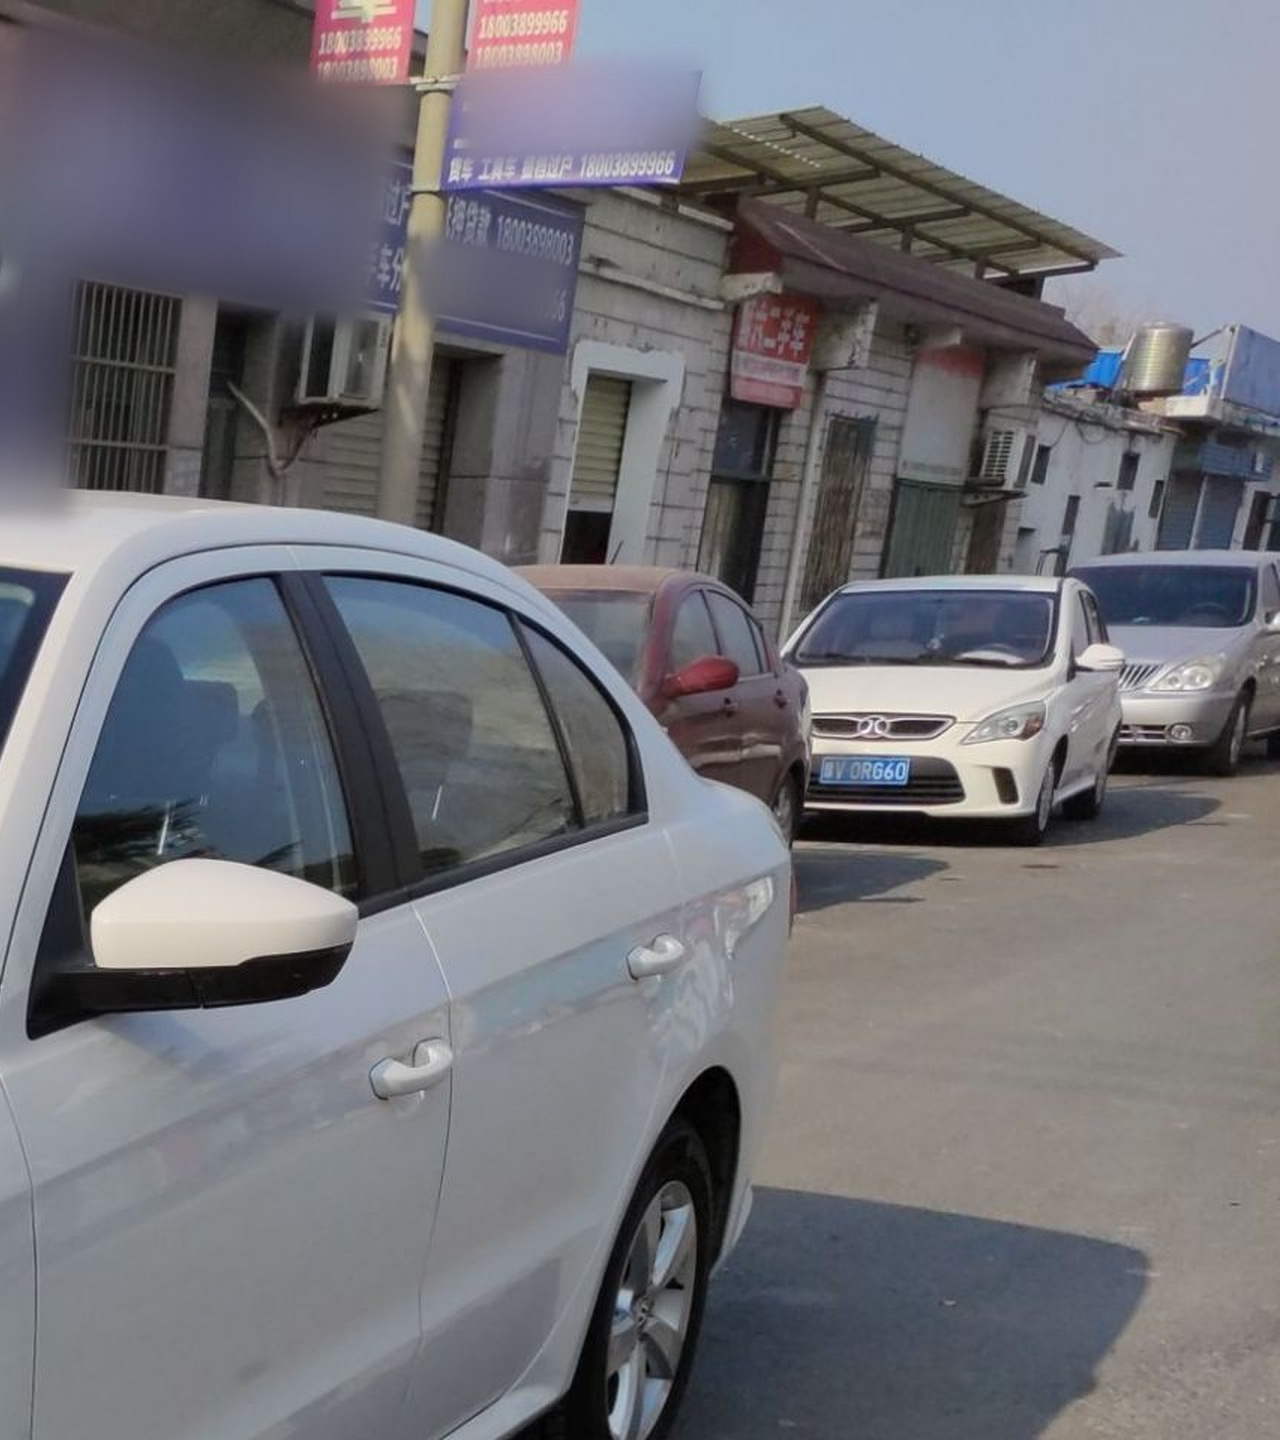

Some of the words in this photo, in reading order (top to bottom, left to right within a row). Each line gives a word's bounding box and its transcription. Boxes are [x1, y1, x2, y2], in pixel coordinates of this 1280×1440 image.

[479, 9, 568, 39] 18003899966
[580, 151, 676, 178] 18003899966
[497, 214, 574, 265] 18003898003
